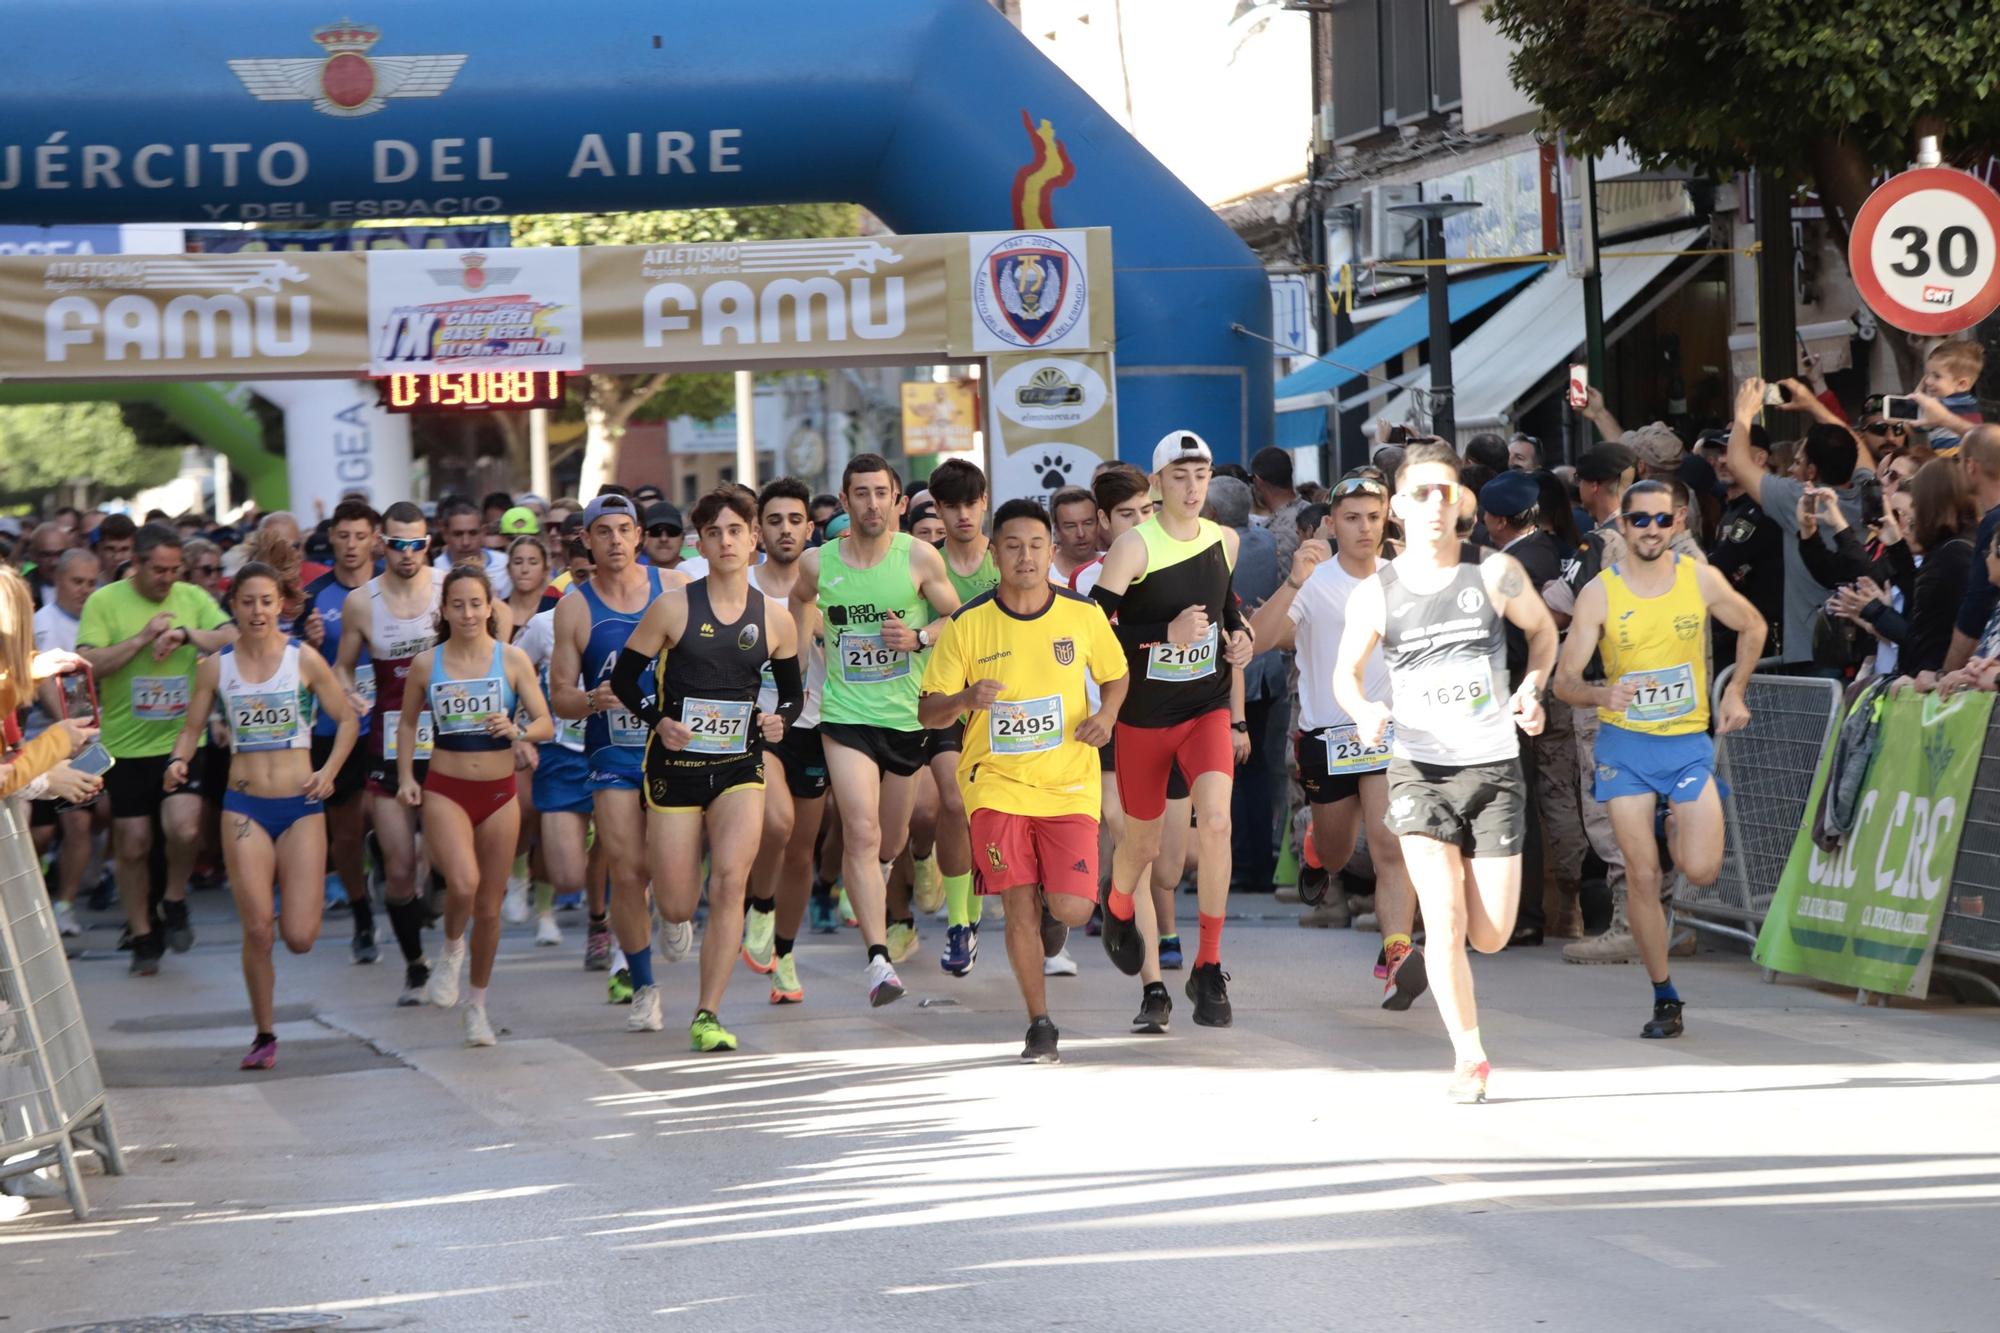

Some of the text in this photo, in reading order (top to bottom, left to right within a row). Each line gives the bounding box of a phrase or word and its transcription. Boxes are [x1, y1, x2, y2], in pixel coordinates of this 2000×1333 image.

[373, 137, 509, 184] DEL
[567, 128, 743, 178] AIRE
[202, 195, 503, 220] Y DEL ESPACIO
[1031, 238, 1053, 248] 2022
[1889, 225, 1978, 278] 30
[642, 246, 741, 265] ATLETISMO
[46, 261, 146, 278] ATLETISMO
[445, 310, 533, 326] CARRERA
[643, 276, 906, 348] FAMU
[45, 294, 311, 362] FAMU
[441, 328, 486, 341] BASE
[434, 341, 566, 358] ALCANARILLA
[849, 602, 876, 615] pan
[850, 608, 906, 625] moreo
[849, 650, 899, 666] 2167
[977, 650, 1012, 665] marathon
[1159, 645, 1210, 664] 2100
[1423, 681, 1481, 706] 1626
[1634, 682, 1685, 705] 1717
[441, 696, 491, 715] 1901
[239, 708, 291, 727] 2403
[690, 717, 742, 735] 2457
[998, 715, 1055, 735] 2495
[1874, 790, 1956, 900] CRC
